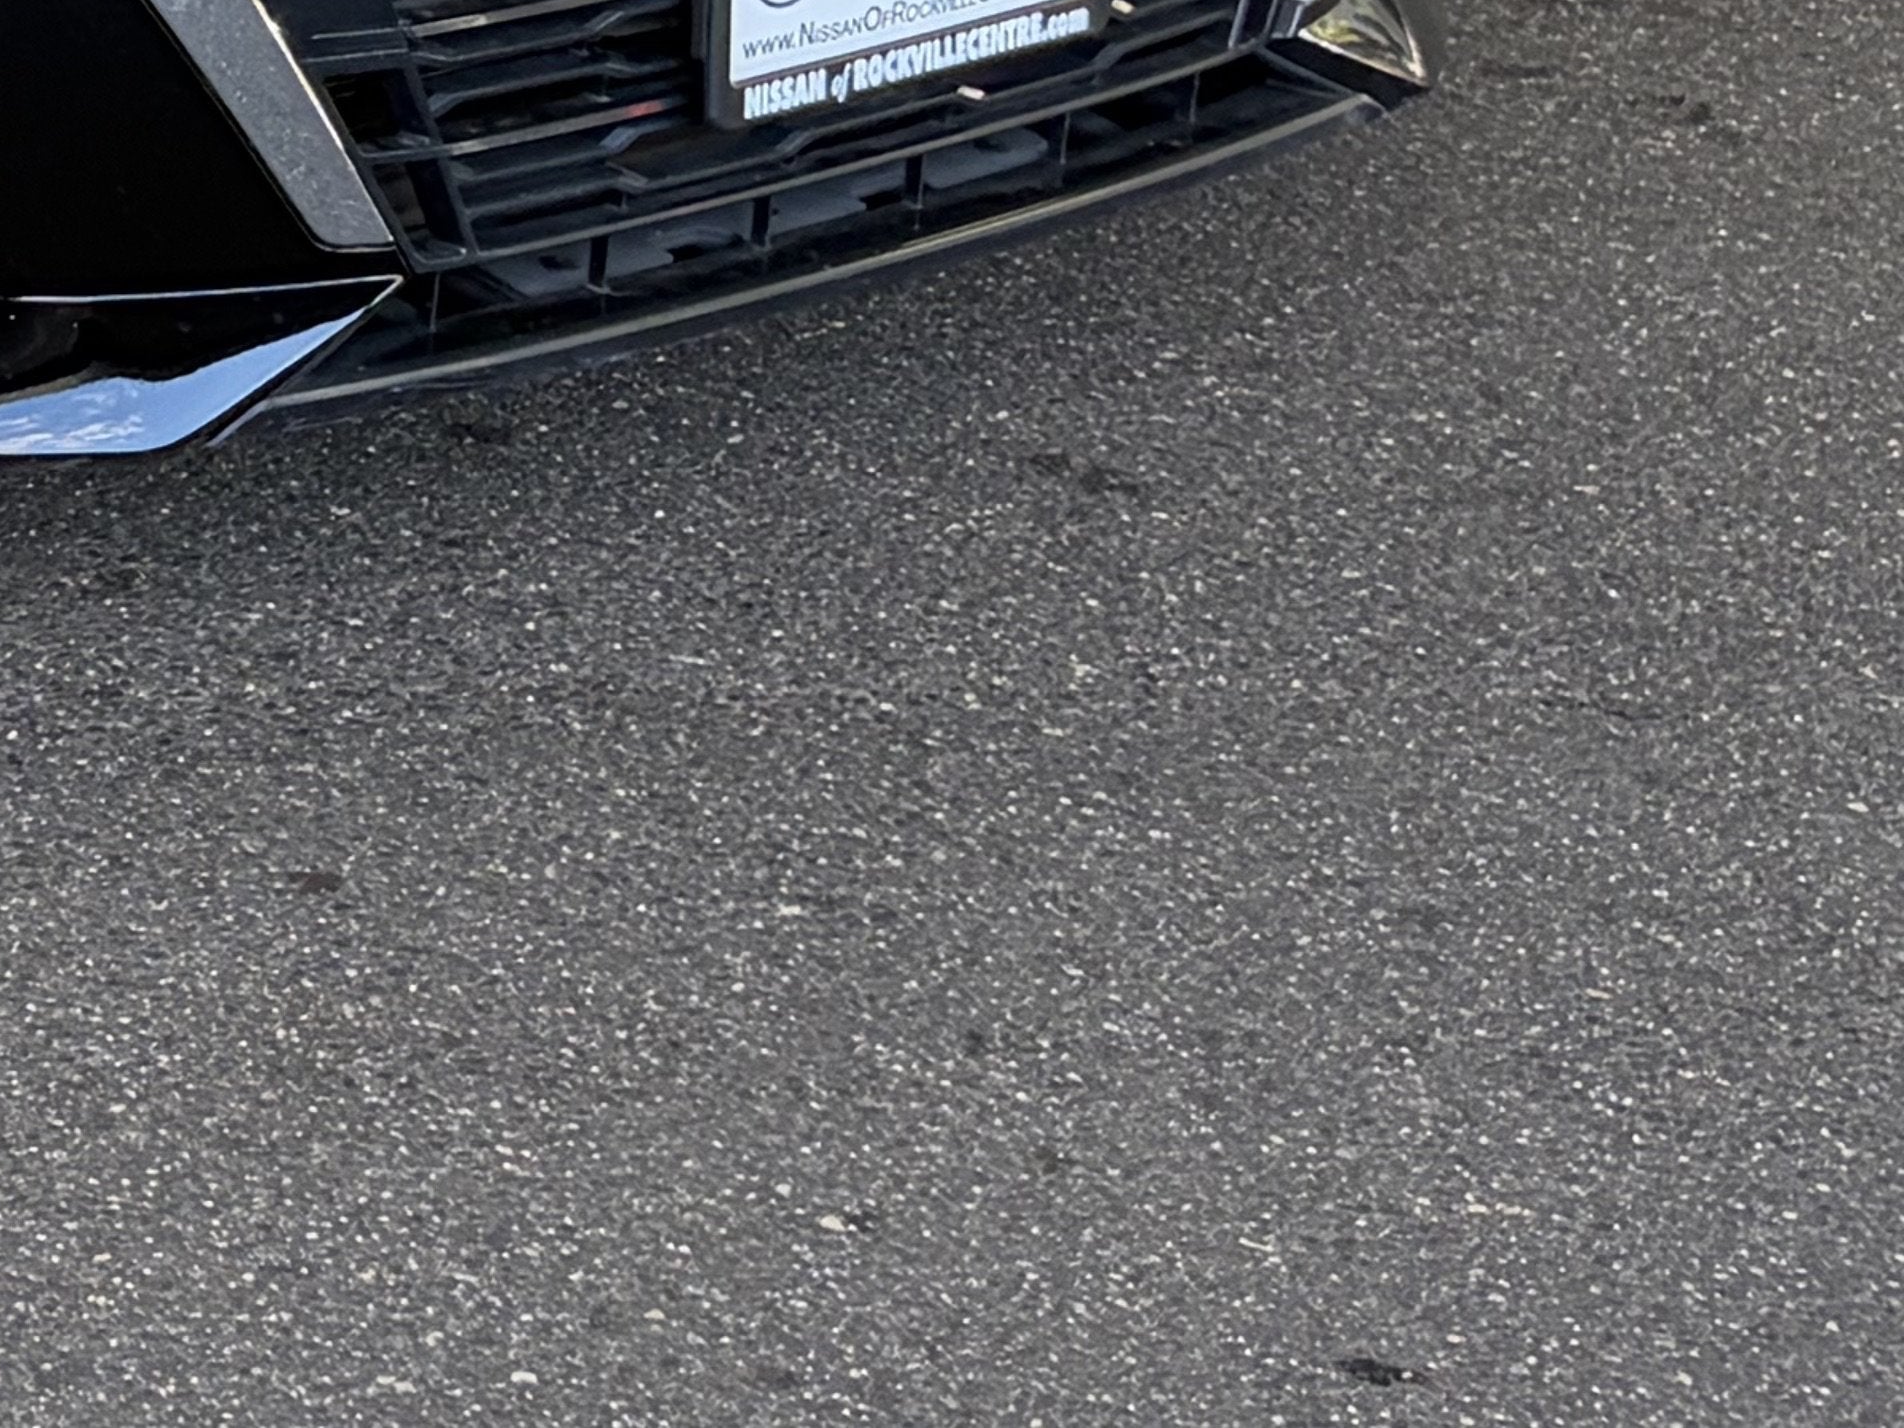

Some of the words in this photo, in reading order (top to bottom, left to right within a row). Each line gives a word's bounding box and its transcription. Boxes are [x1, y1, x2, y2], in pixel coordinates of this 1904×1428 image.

[744, 68, 828, 120] NISSAN
[831, 61, 853, 103] of
[854, 6, 1090, 92] ROCKVILLECENTRE.com
